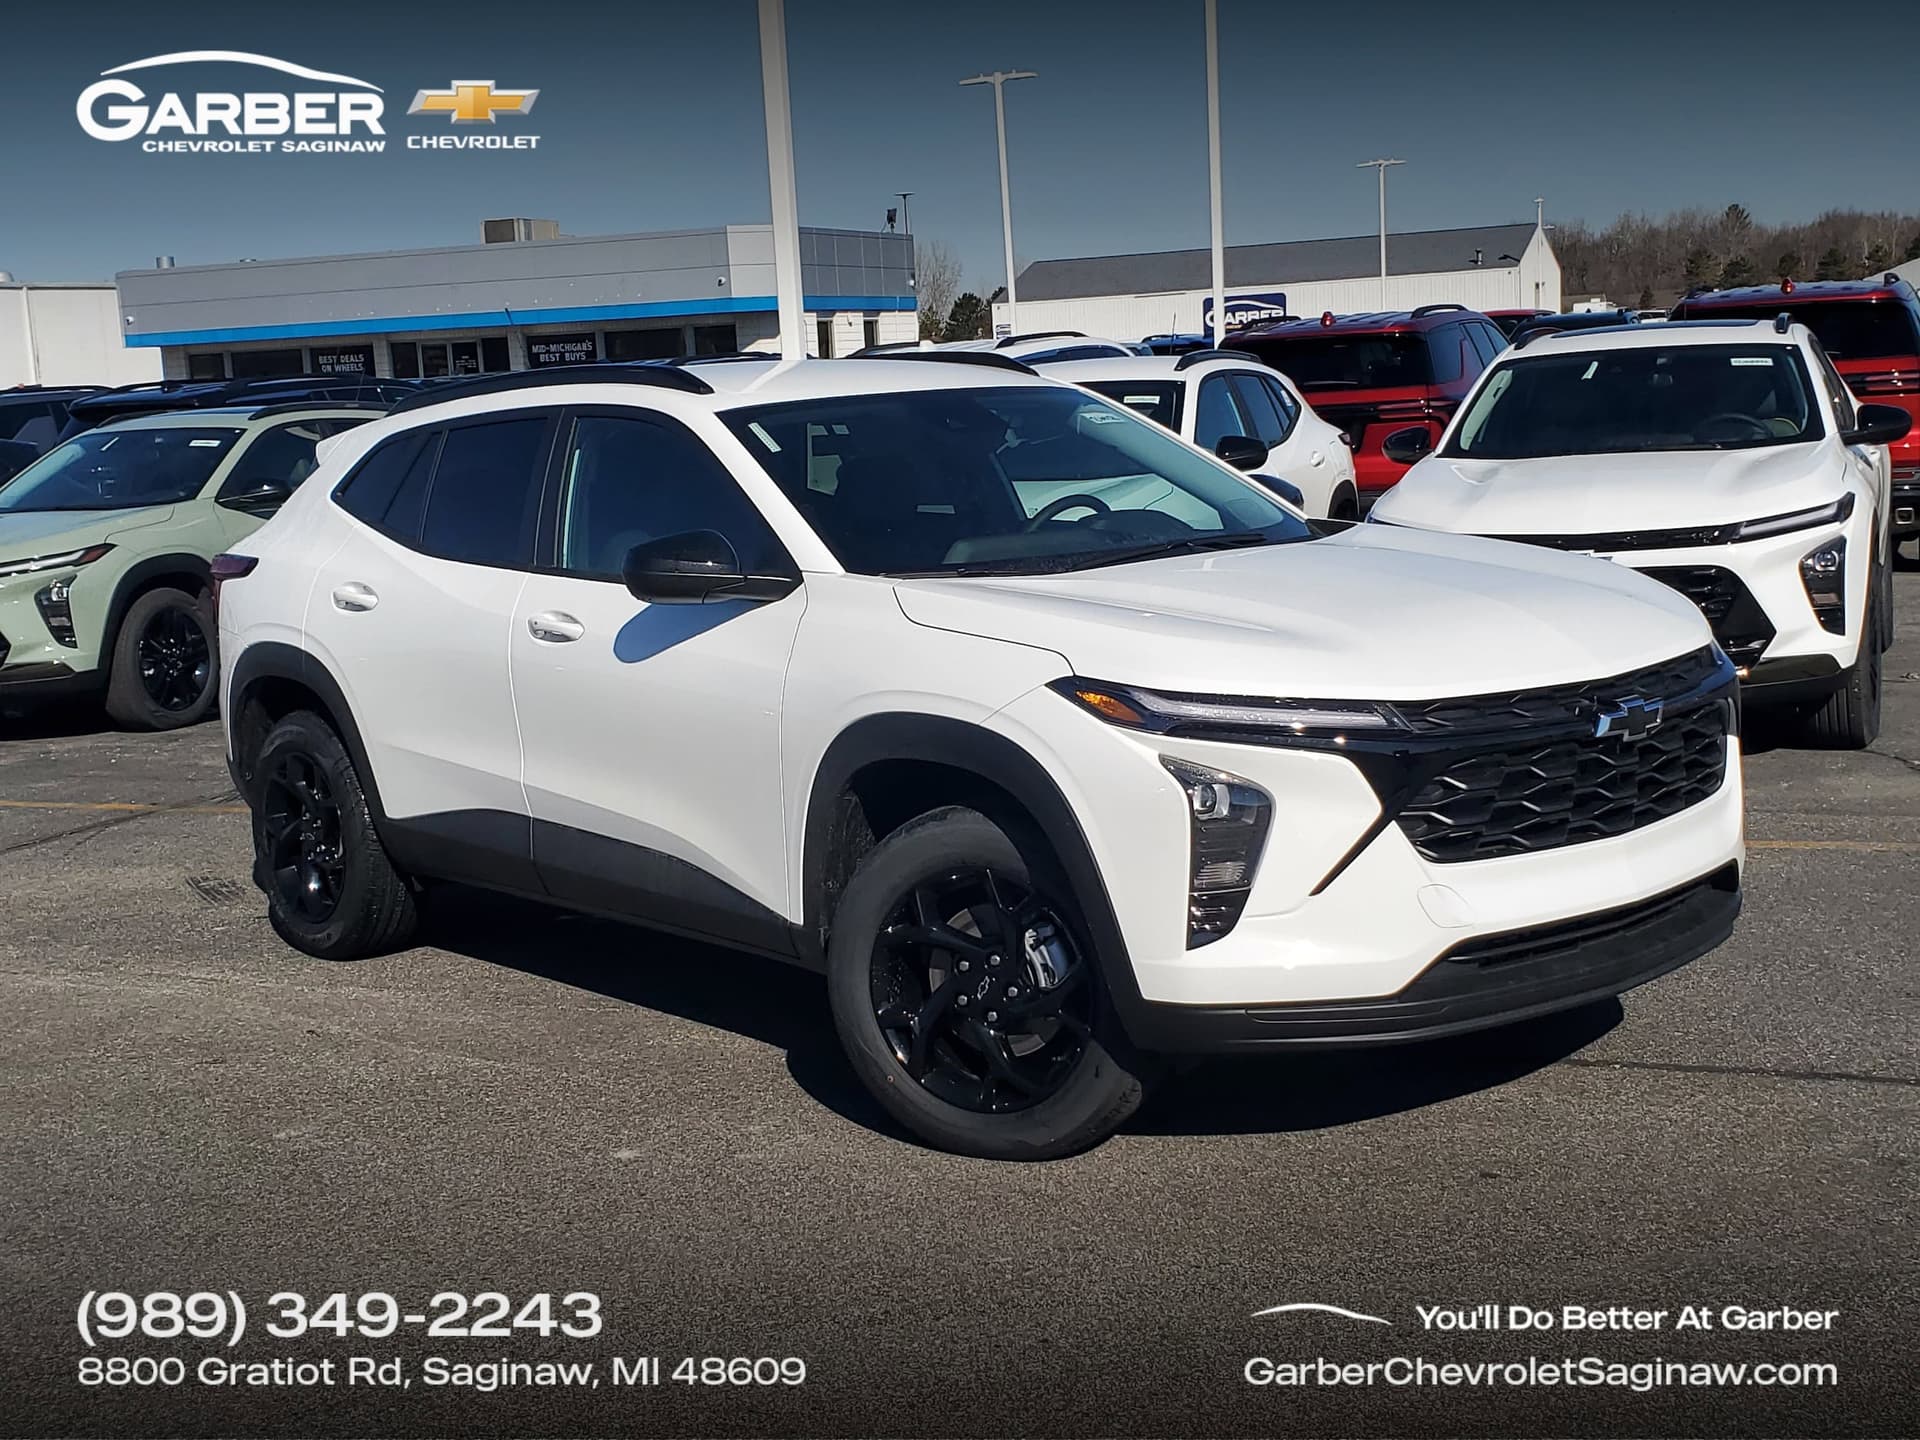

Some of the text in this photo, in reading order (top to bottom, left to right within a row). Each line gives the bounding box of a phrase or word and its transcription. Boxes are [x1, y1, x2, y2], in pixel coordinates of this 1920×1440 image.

[318, 354, 365, 365] BEST DEALS
[539, 352, 587, 362] BEST BUYS
[321, 363, 364, 373] ON WHEELS
